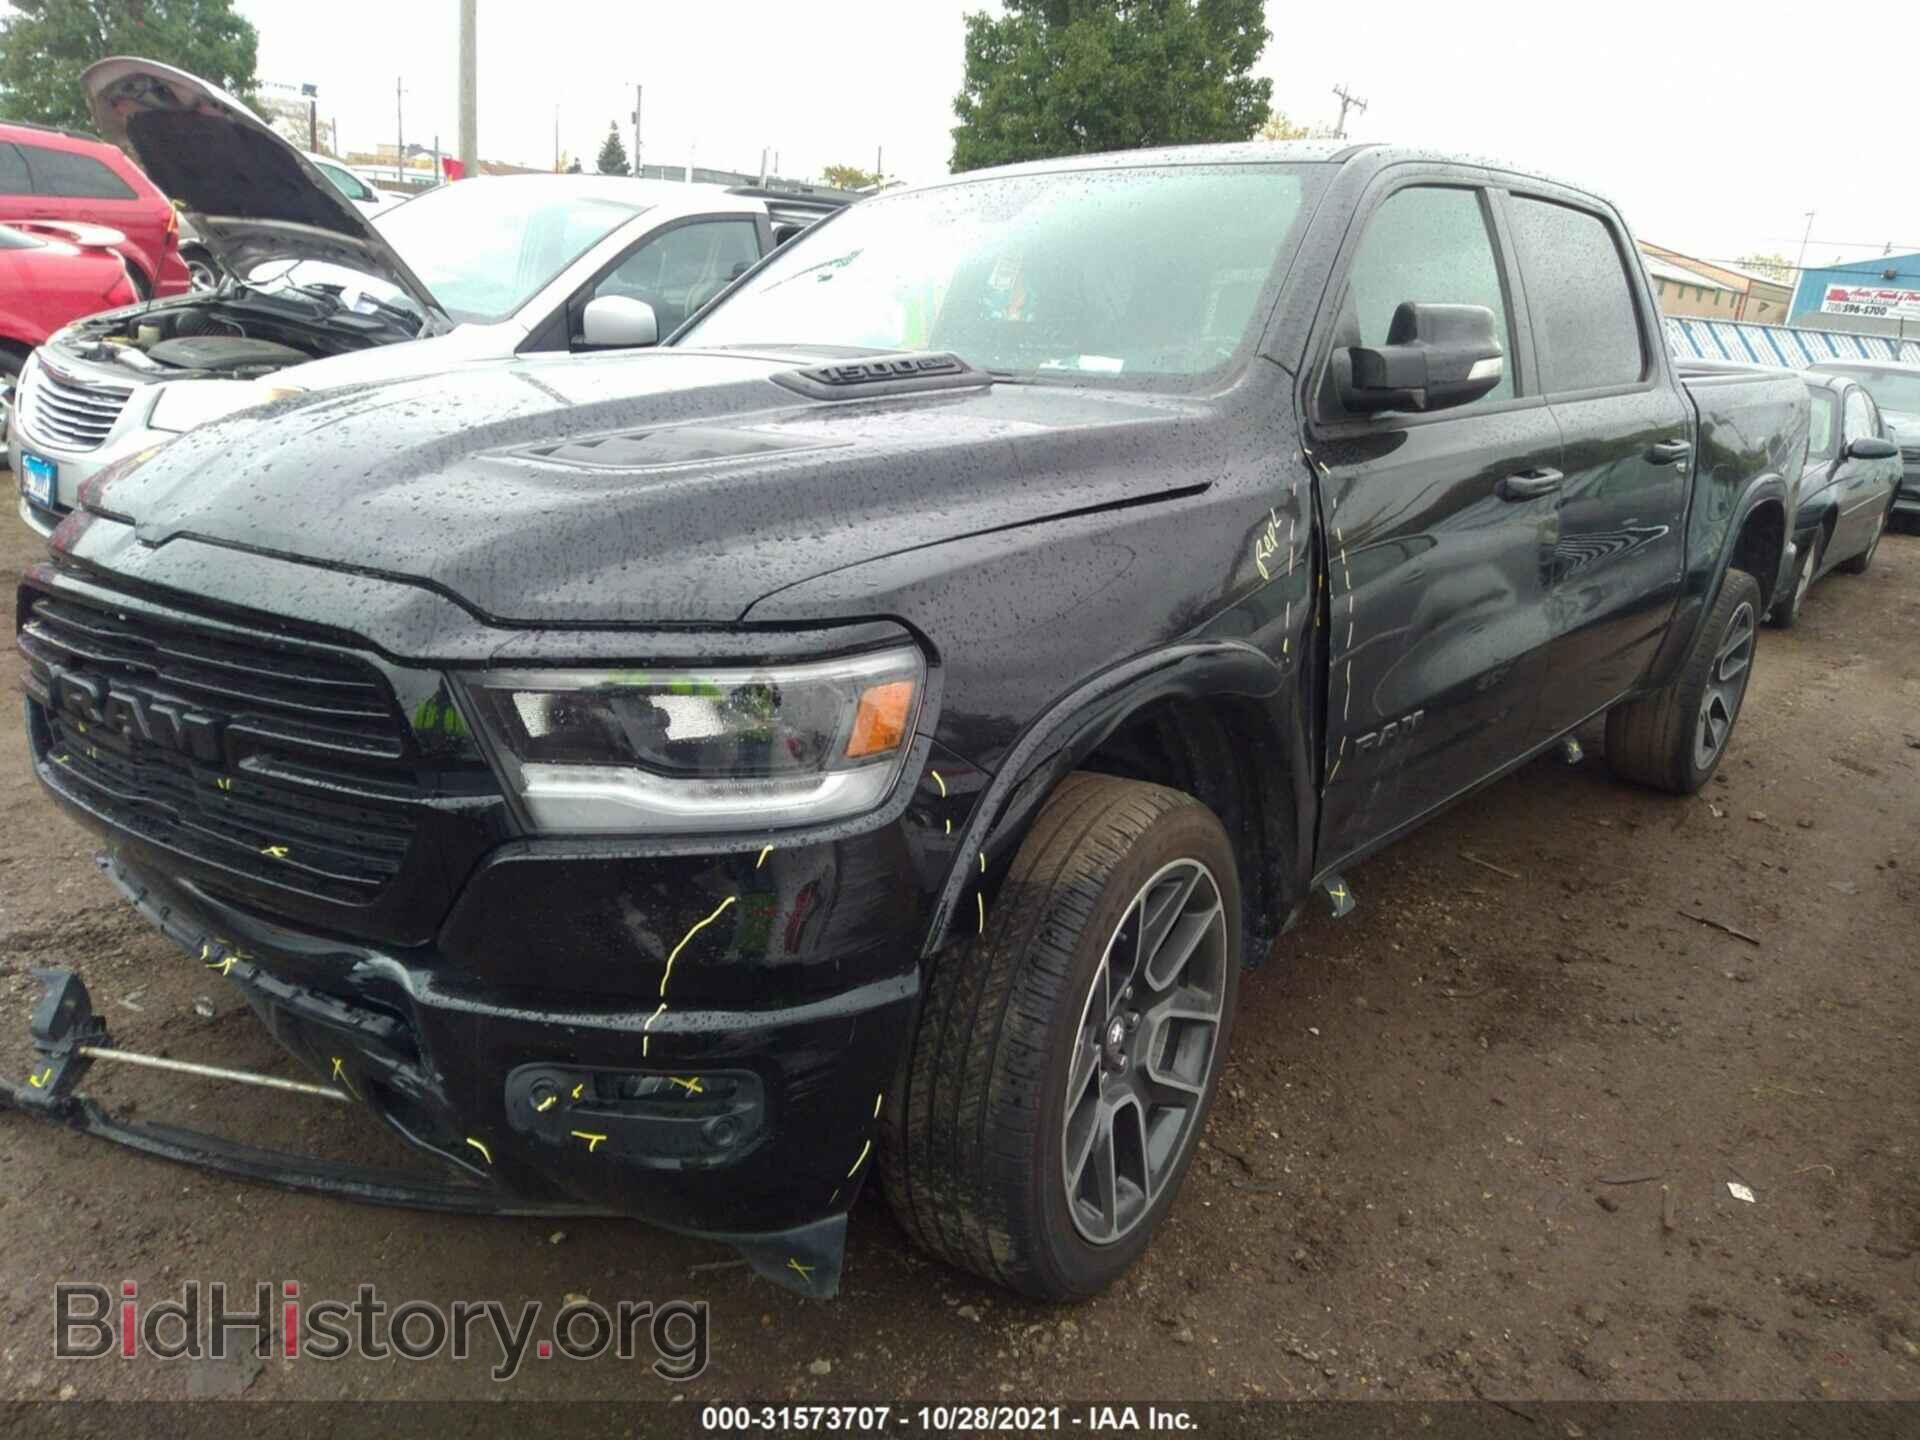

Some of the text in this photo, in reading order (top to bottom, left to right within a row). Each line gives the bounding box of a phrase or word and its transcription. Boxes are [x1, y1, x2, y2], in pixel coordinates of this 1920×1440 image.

[820, 358, 919, 383] 1500
[50, 665, 226, 768] RAM
[1354, 708, 1425, 756] RAM
